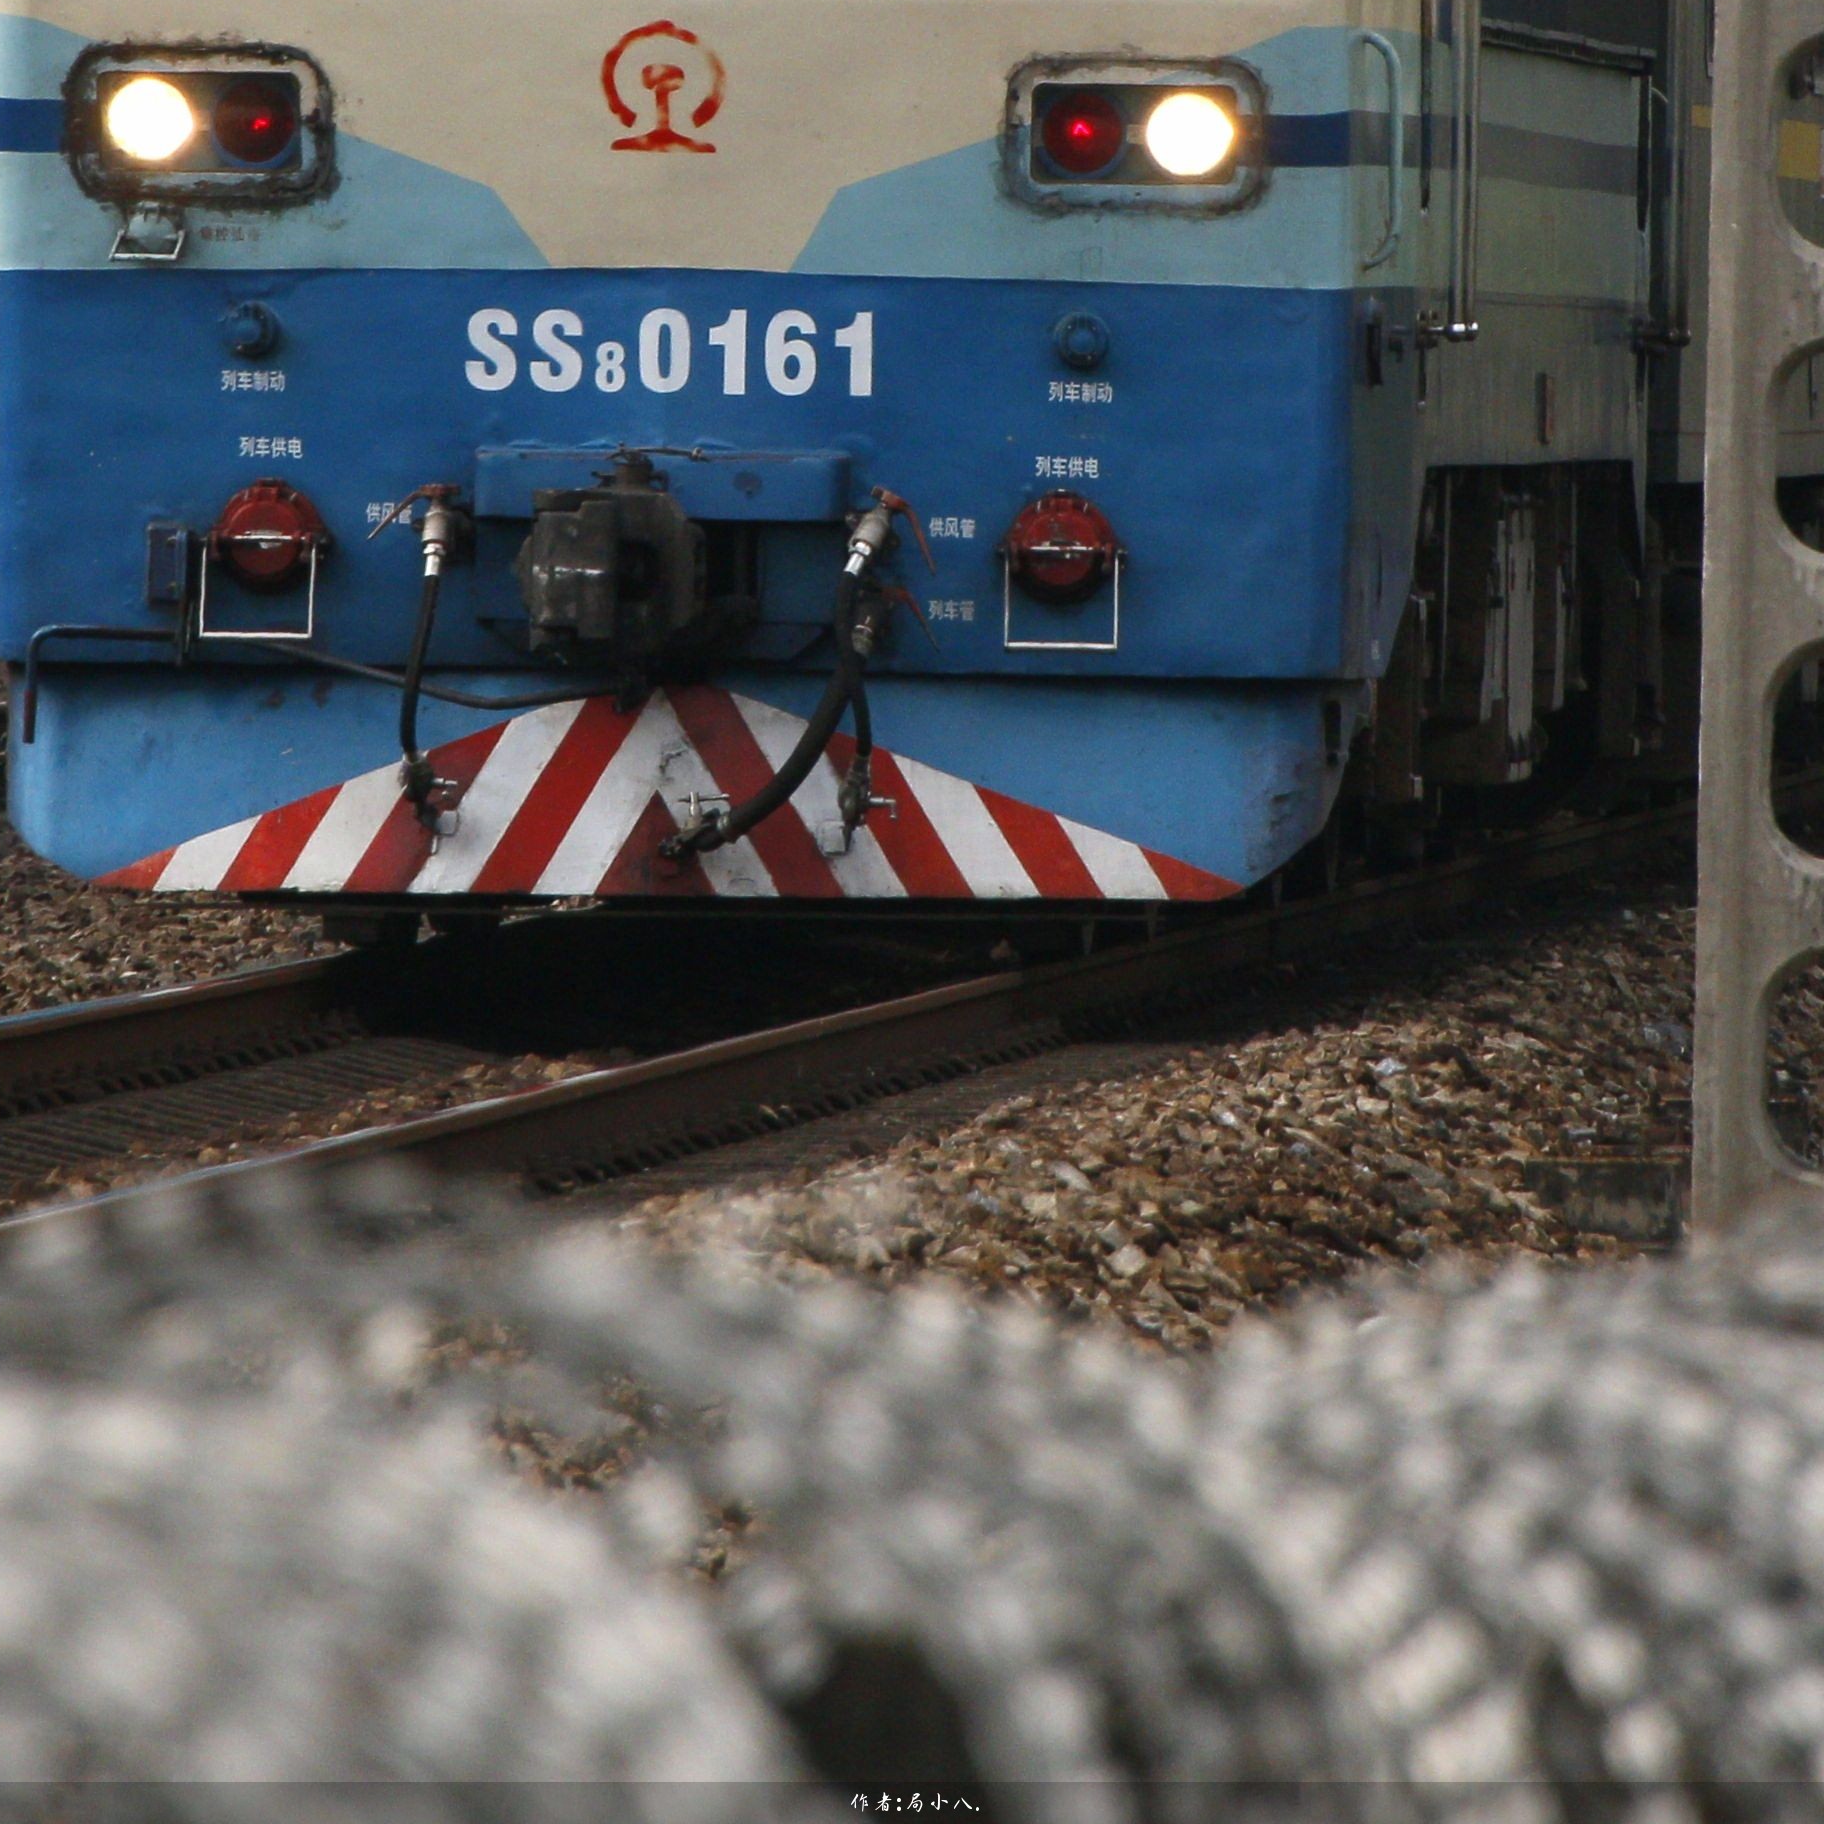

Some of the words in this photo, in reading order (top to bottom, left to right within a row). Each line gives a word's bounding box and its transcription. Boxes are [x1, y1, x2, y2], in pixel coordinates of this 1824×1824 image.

[220, 370, 286, 392] 列车制动
[1048, 382, 1113, 403] 列车制动
[239, 437, 303, 459] 列车供电
[1035, 456, 1099, 479] 列车供电
[929, 517, 975, 539] 供风管
[928, 600, 975, 621] 列车管
